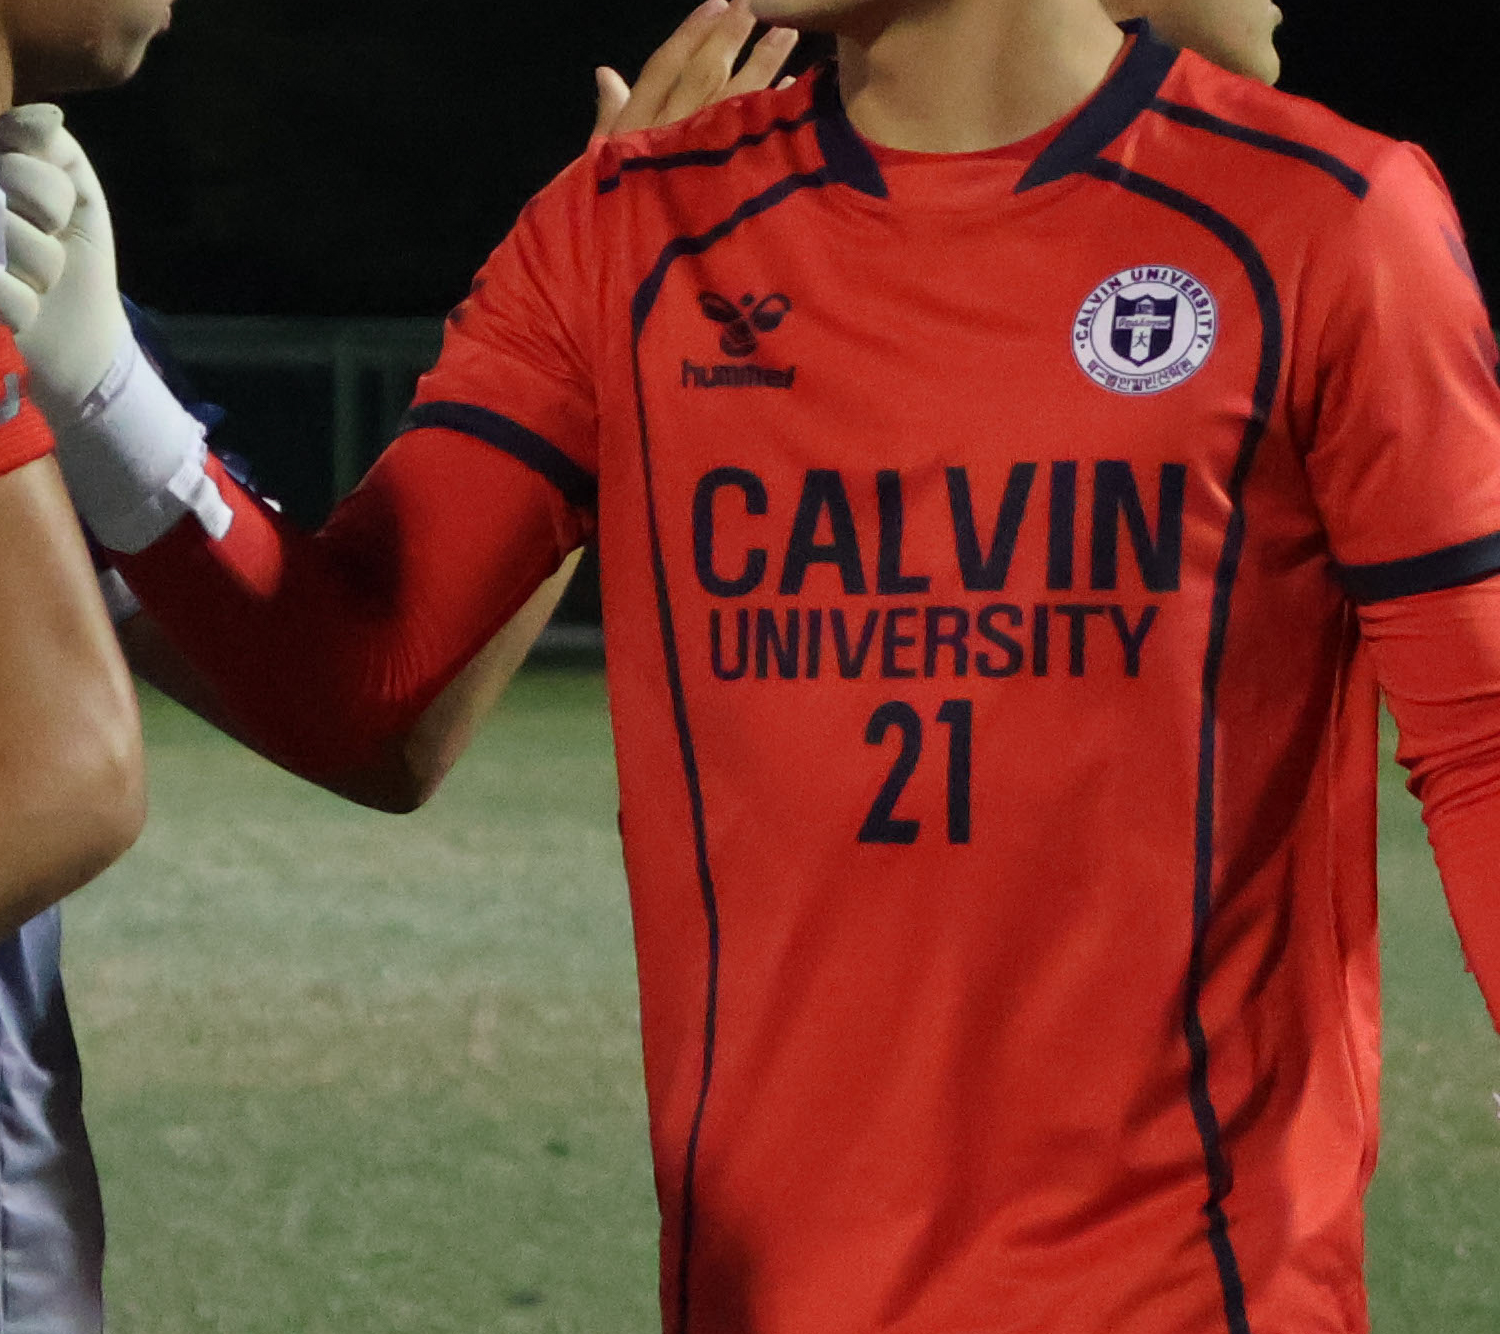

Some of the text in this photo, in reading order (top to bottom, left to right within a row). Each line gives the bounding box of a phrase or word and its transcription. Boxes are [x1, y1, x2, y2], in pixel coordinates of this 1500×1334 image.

[1075, 268, 1212, 344] CALVIN UNIVERSITY
[691, 460, 1188, 598] CALVIN
[709, 603, 1161, 681] UNIVERSITY
[856, 699, 973, 845] 21
